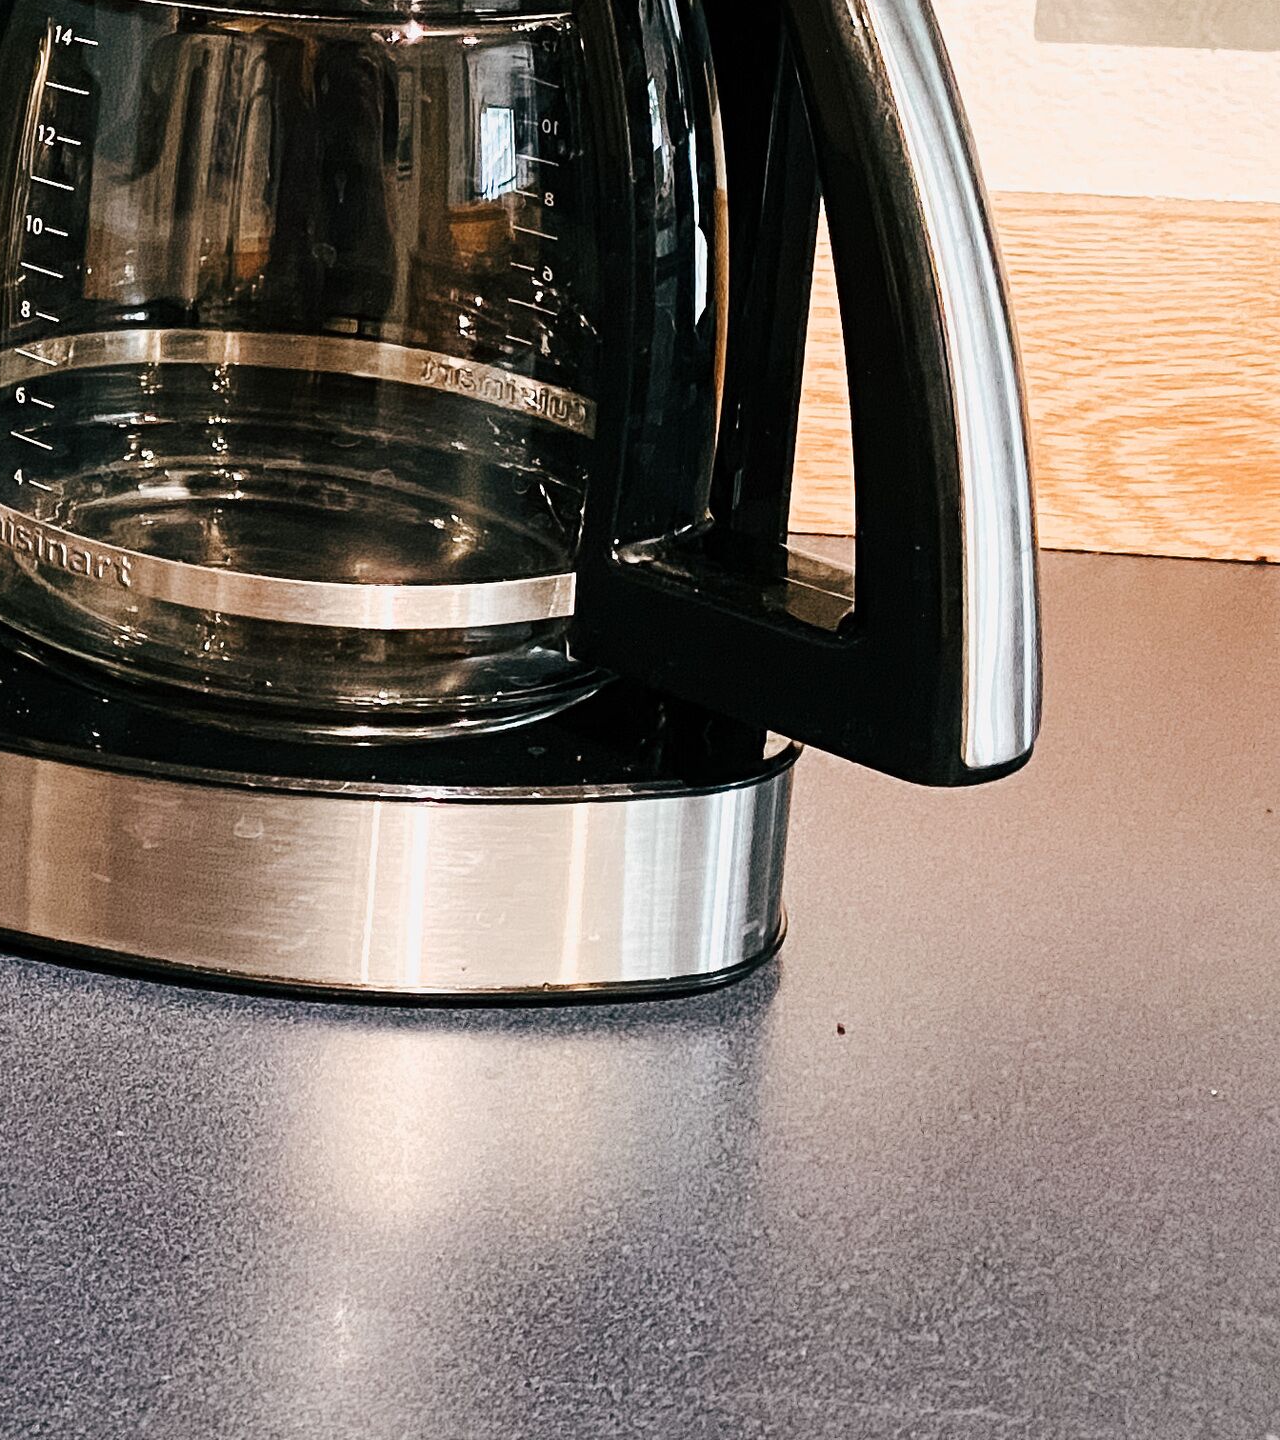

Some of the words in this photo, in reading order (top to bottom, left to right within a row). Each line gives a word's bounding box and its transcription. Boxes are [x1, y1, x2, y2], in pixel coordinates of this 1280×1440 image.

[54, 24, 73, 46] 14
[38, 124, 57, 146] 12
[25, 214, 44, 236] 10
[20, 300, 31, 318] 8
[14, 386, 26, 404] 6
[13, 468, 24, 486] 4
